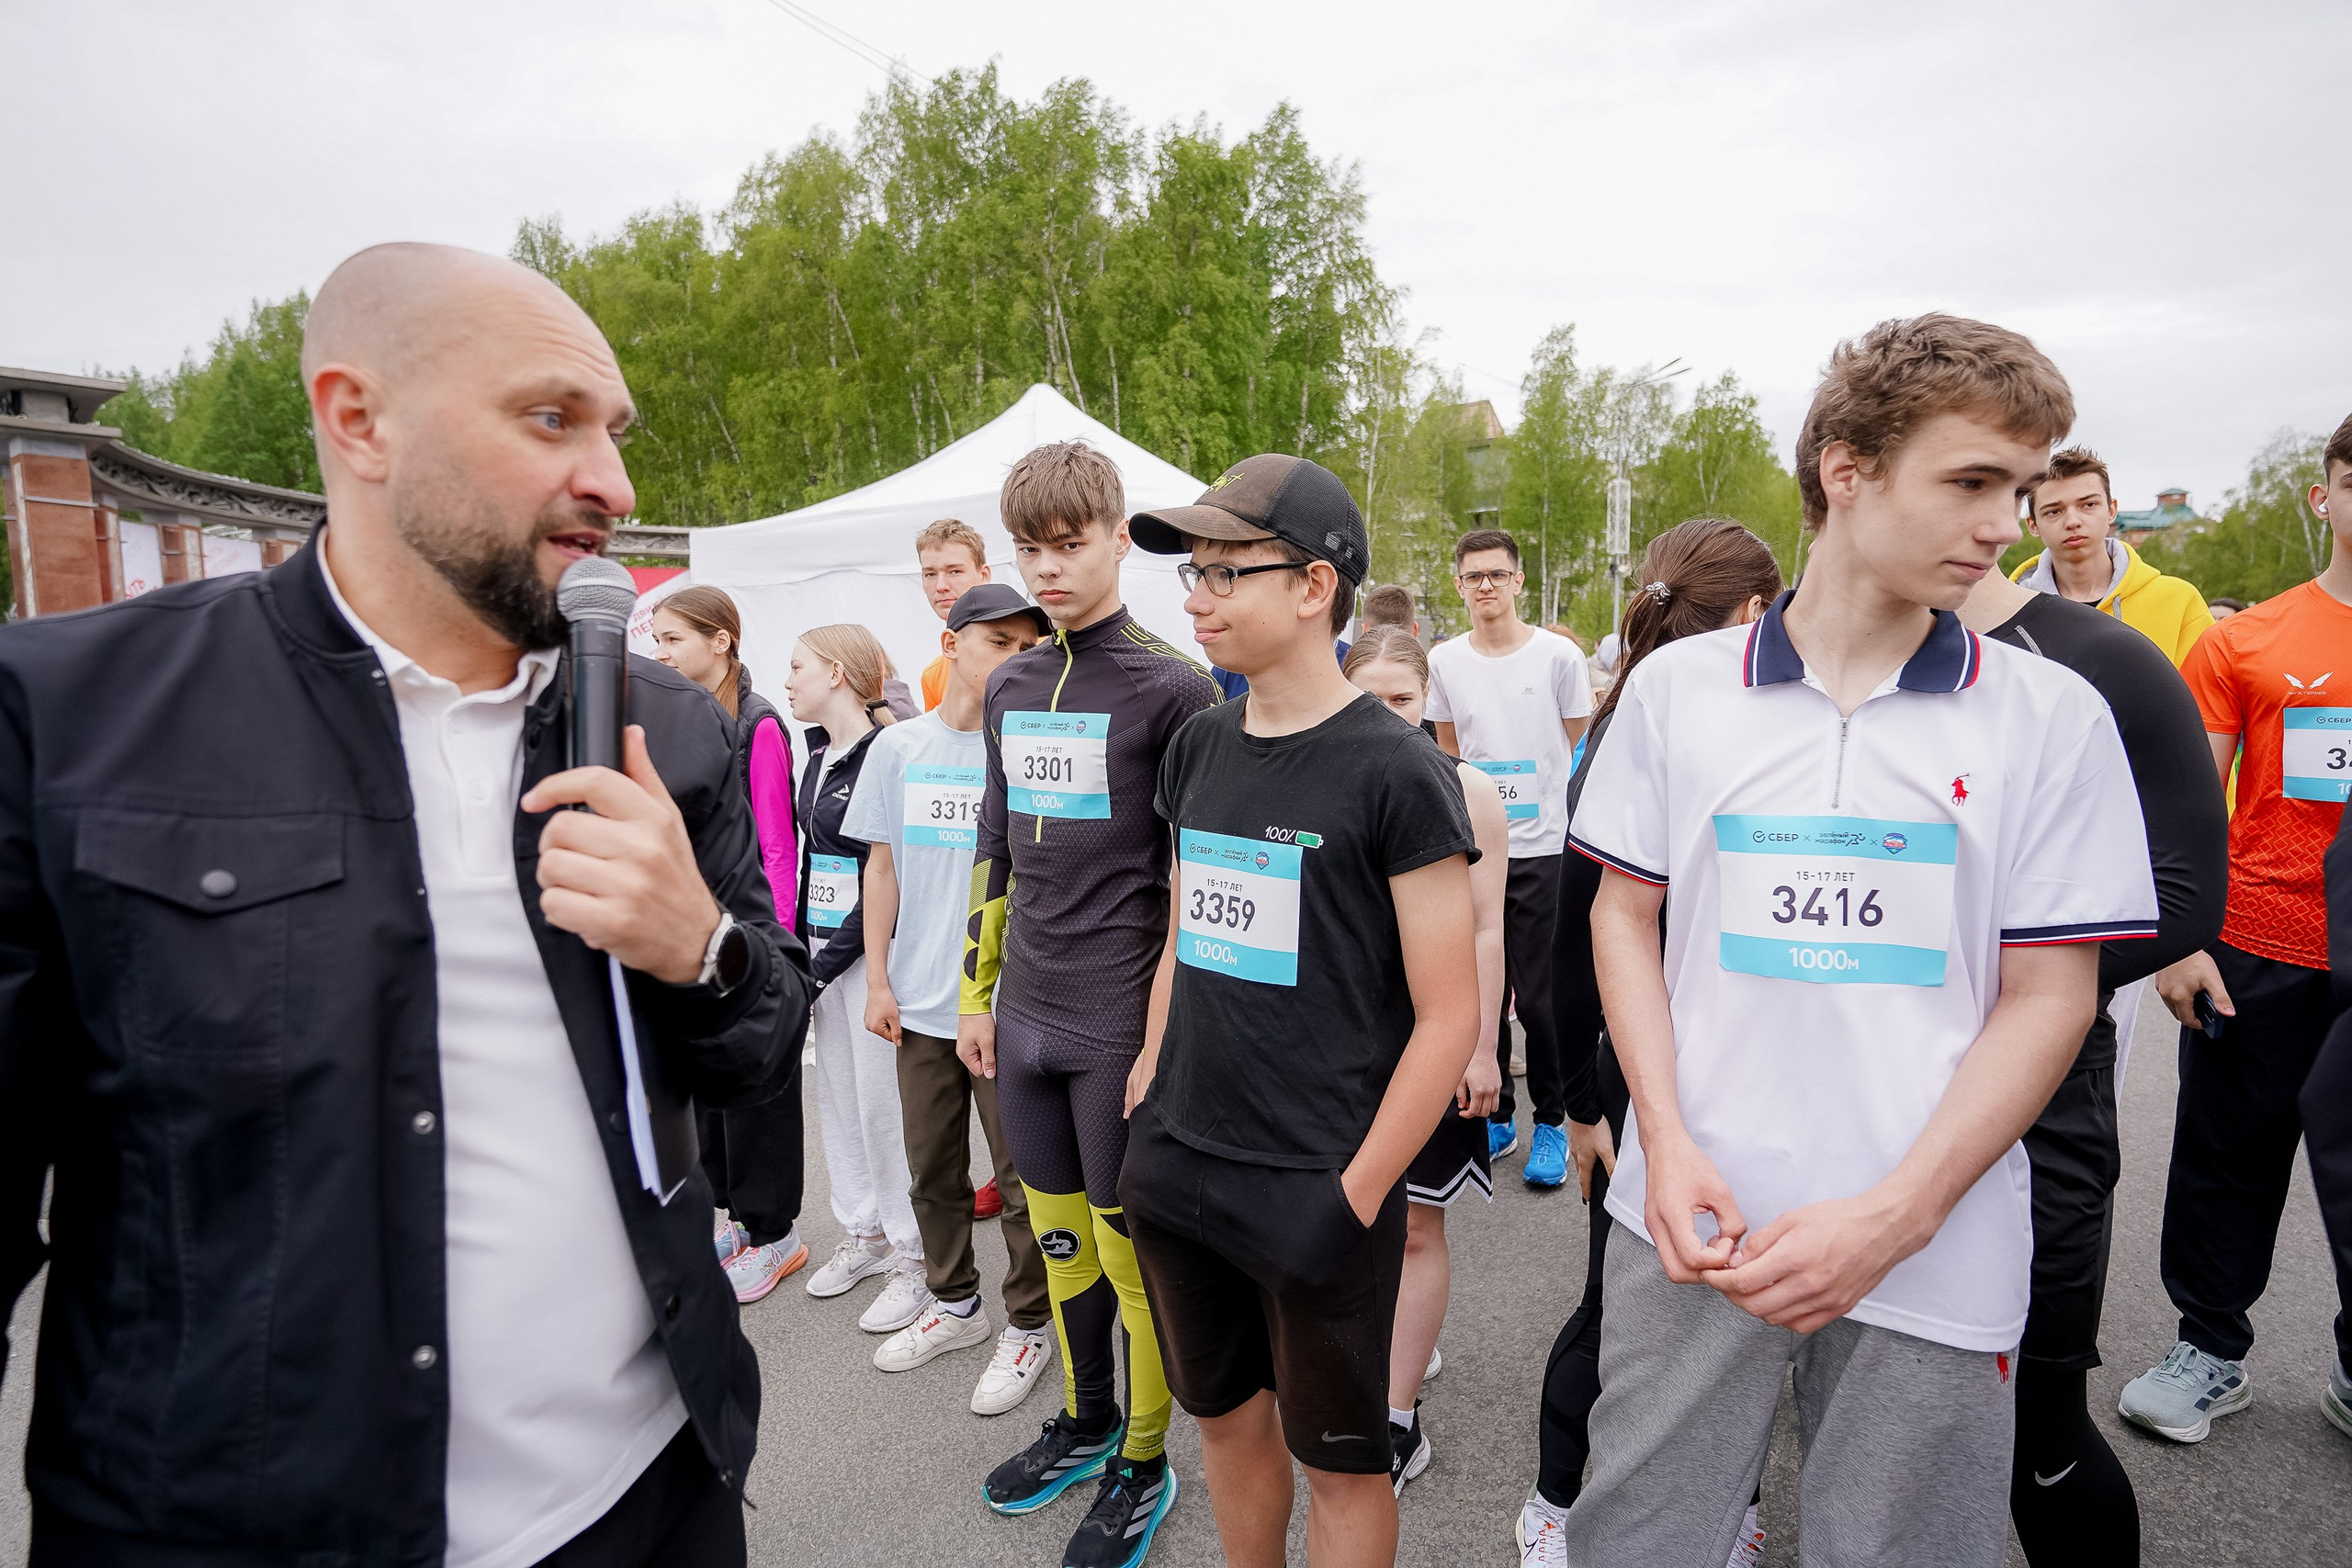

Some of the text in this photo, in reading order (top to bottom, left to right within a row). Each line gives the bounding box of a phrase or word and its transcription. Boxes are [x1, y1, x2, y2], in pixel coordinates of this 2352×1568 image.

[1024, 755, 1072, 783] 3301
[931, 799, 982, 822] 3319
[1264, 825, 1296, 842] 100%
[1768, 832, 1799, 842] СБЕР
[1196, 845, 1213, 854] СБЕР
[1206, 878, 1243, 892] 15-17 ЛЕТ
[1796, 871, 1855, 882] 15-17 ЛЕТ
[809, 884, 835, 903] 3323
[1190, 888, 1256, 932] 3359
[1771, 885, 1883, 927] 3416
